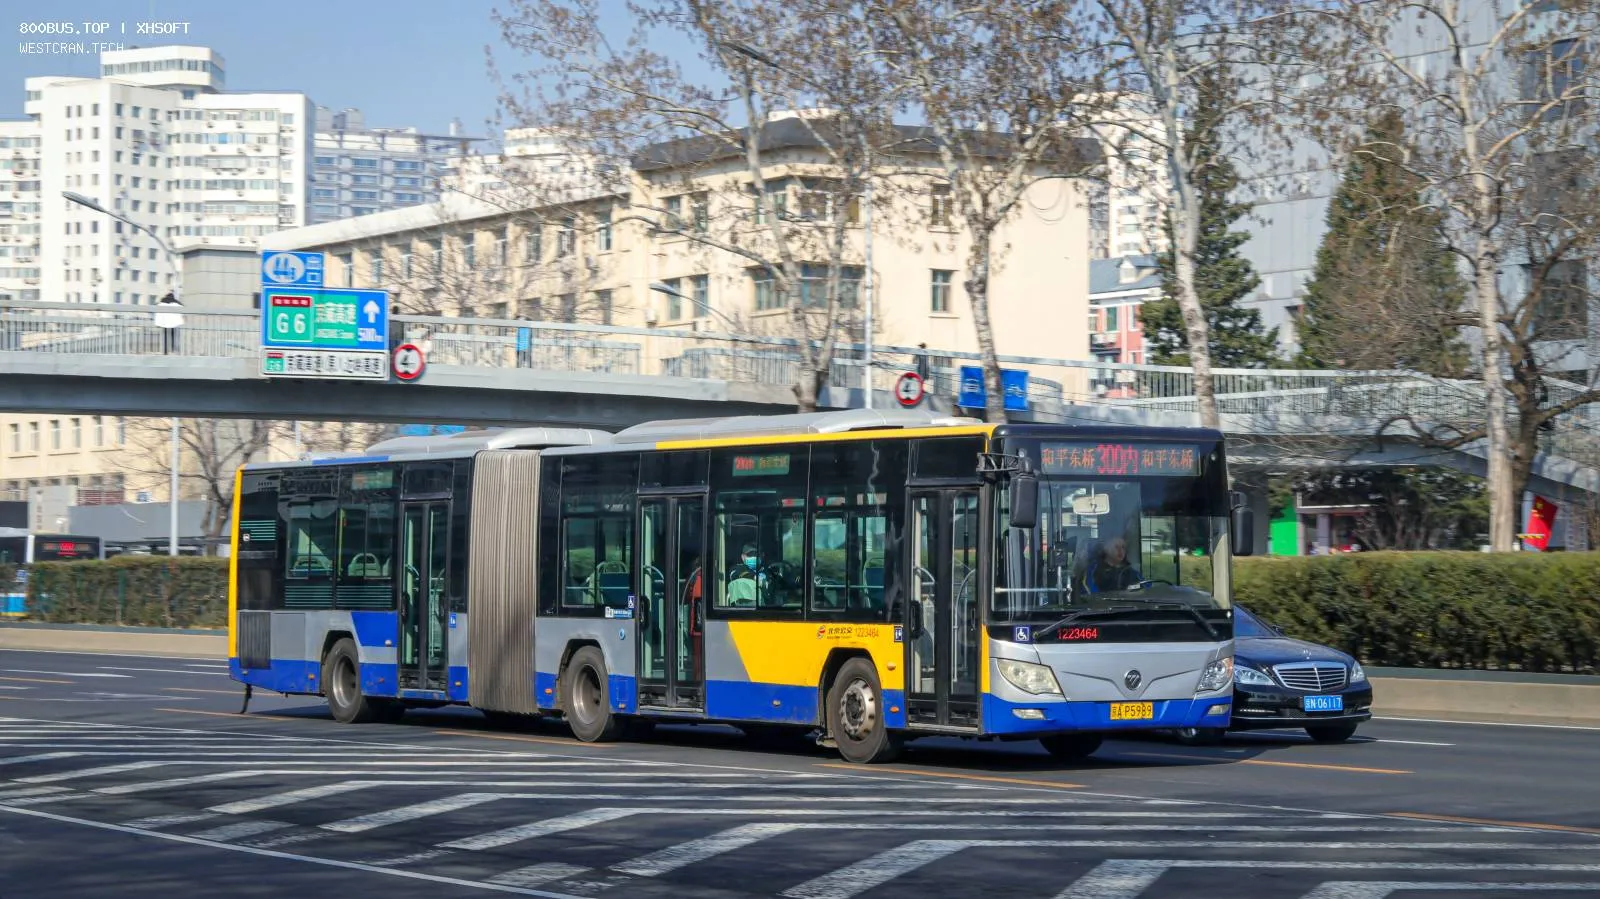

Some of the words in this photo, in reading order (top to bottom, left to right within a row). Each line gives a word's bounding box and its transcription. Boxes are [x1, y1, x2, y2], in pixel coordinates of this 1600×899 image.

[276, 313, 306, 334] G6
[1042, 448, 1095, 469] 和平东桥
[1142, 449, 1194, 469] 和平东桥
[856, 627, 879, 638] 1223464
[1058, 628, 1097, 639] 1223464
